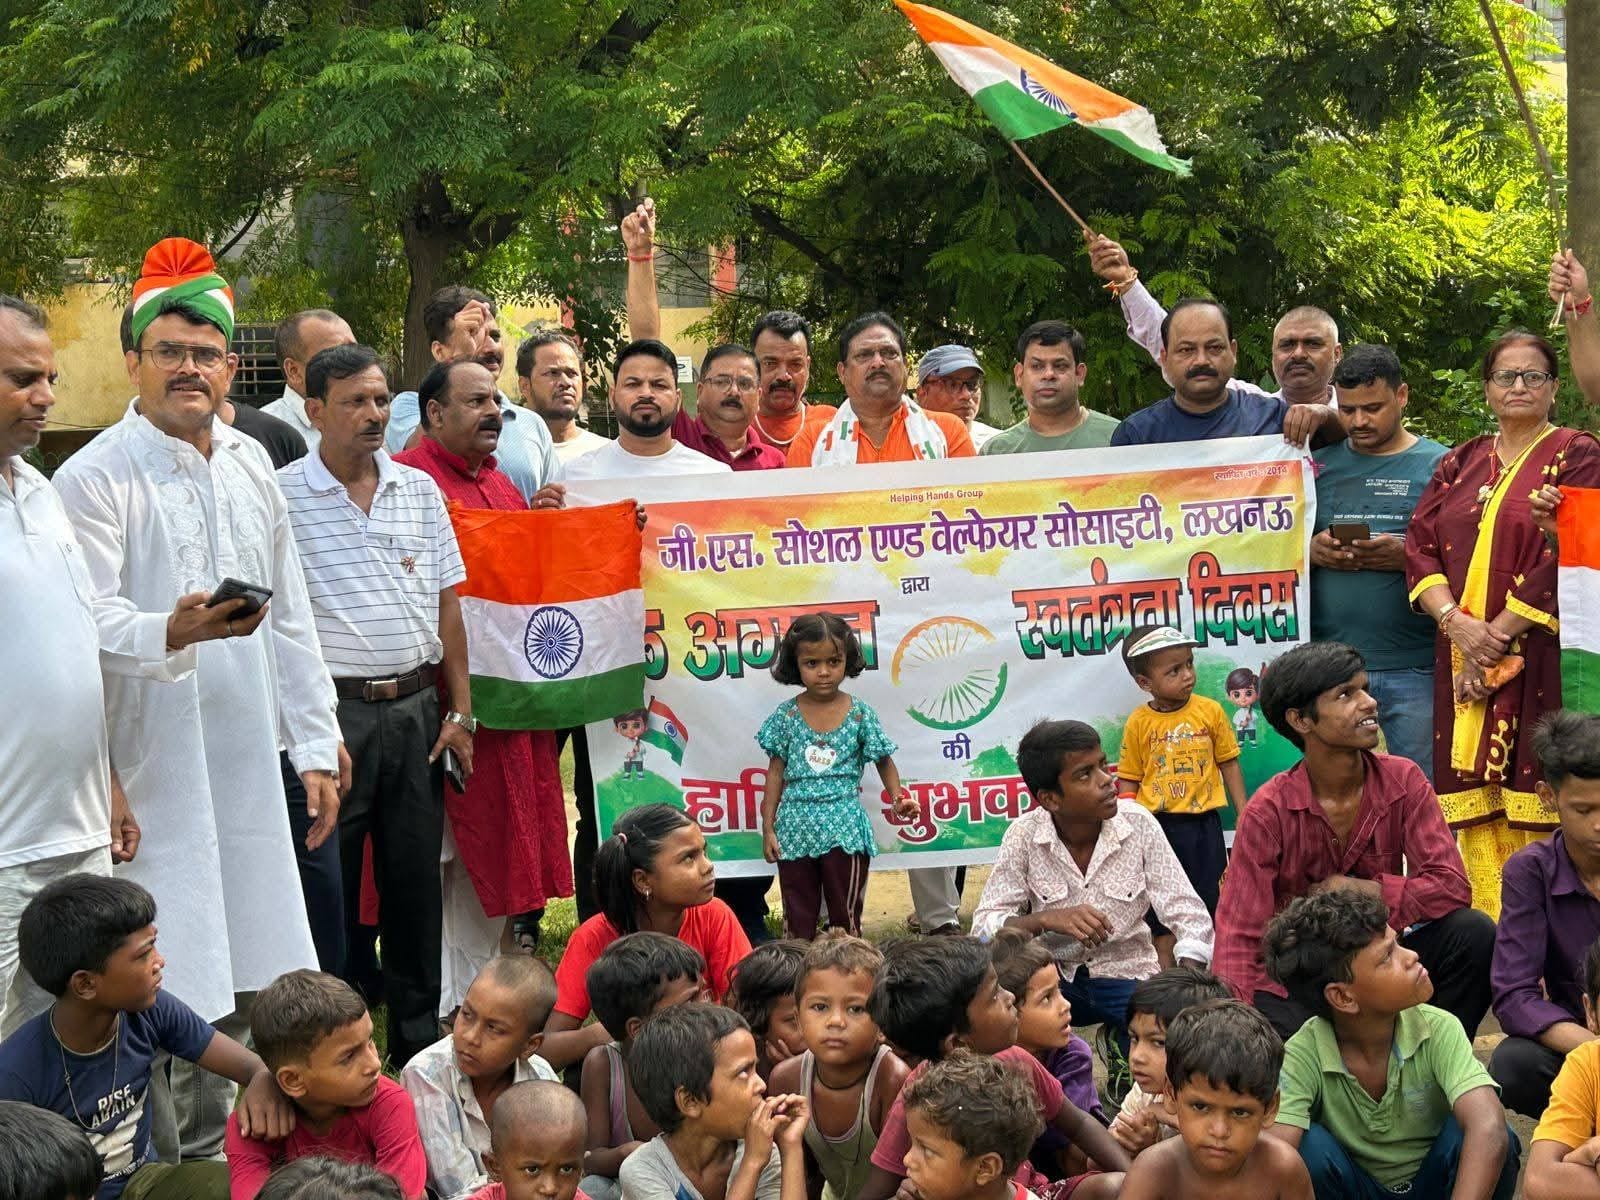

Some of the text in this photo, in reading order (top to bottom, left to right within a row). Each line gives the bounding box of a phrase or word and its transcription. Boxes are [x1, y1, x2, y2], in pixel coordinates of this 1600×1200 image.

[890, 489, 984, 504] Helping Hands Group
[658, 494, 1294, 571] जी.एस. सोशल एण्ड वेल्फेयर सोसाइटी, लखनऊ
[900, 576, 930, 595] द्वारा
[1188, 552, 1300, 649] दिवस
[941, 732, 971, 760] की
[97, 1083, 132, 1111] RISE
[91, 1095, 136, 1129] AGAIN
